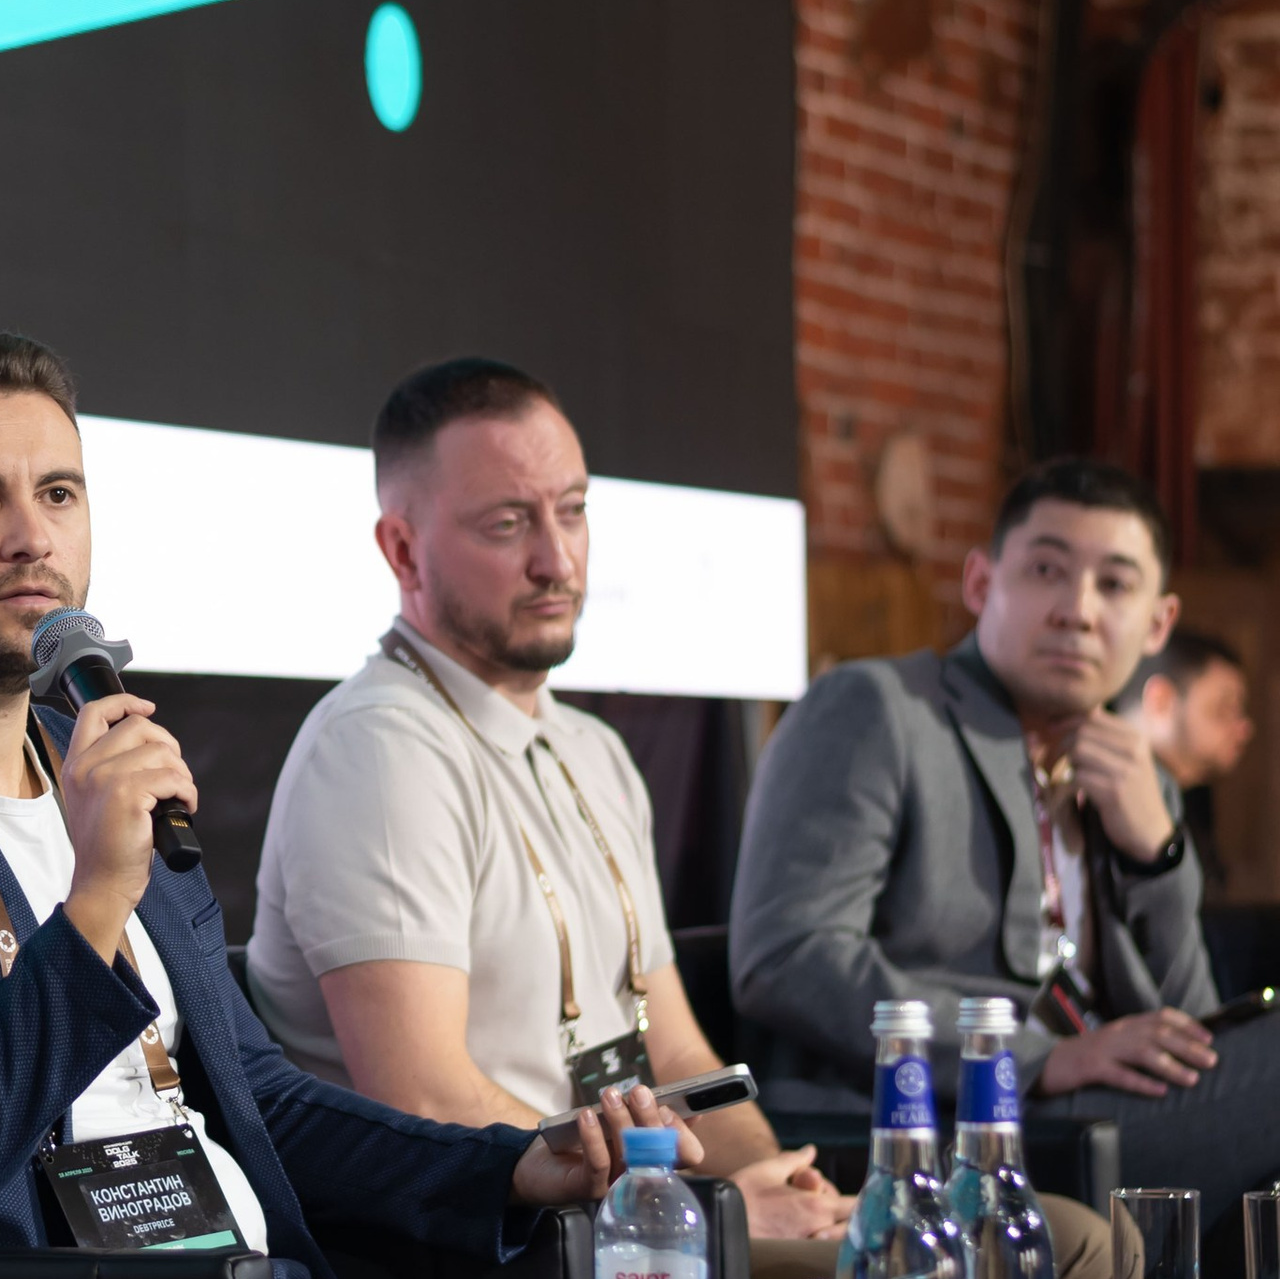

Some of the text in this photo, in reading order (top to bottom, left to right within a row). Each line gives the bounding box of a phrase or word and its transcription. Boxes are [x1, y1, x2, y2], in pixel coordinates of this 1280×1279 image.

[105, 1145, 131, 1156] DOLG
[116, 1150, 140, 1161] TALK
[113, 1158, 138, 1168] 2025
[90, 1174, 184, 1205] КОНСТАНТИН
[98, 1191, 192, 1222] ВИНОГРАДОВ
[133, 1218, 175, 1234] DEBTPRICE
